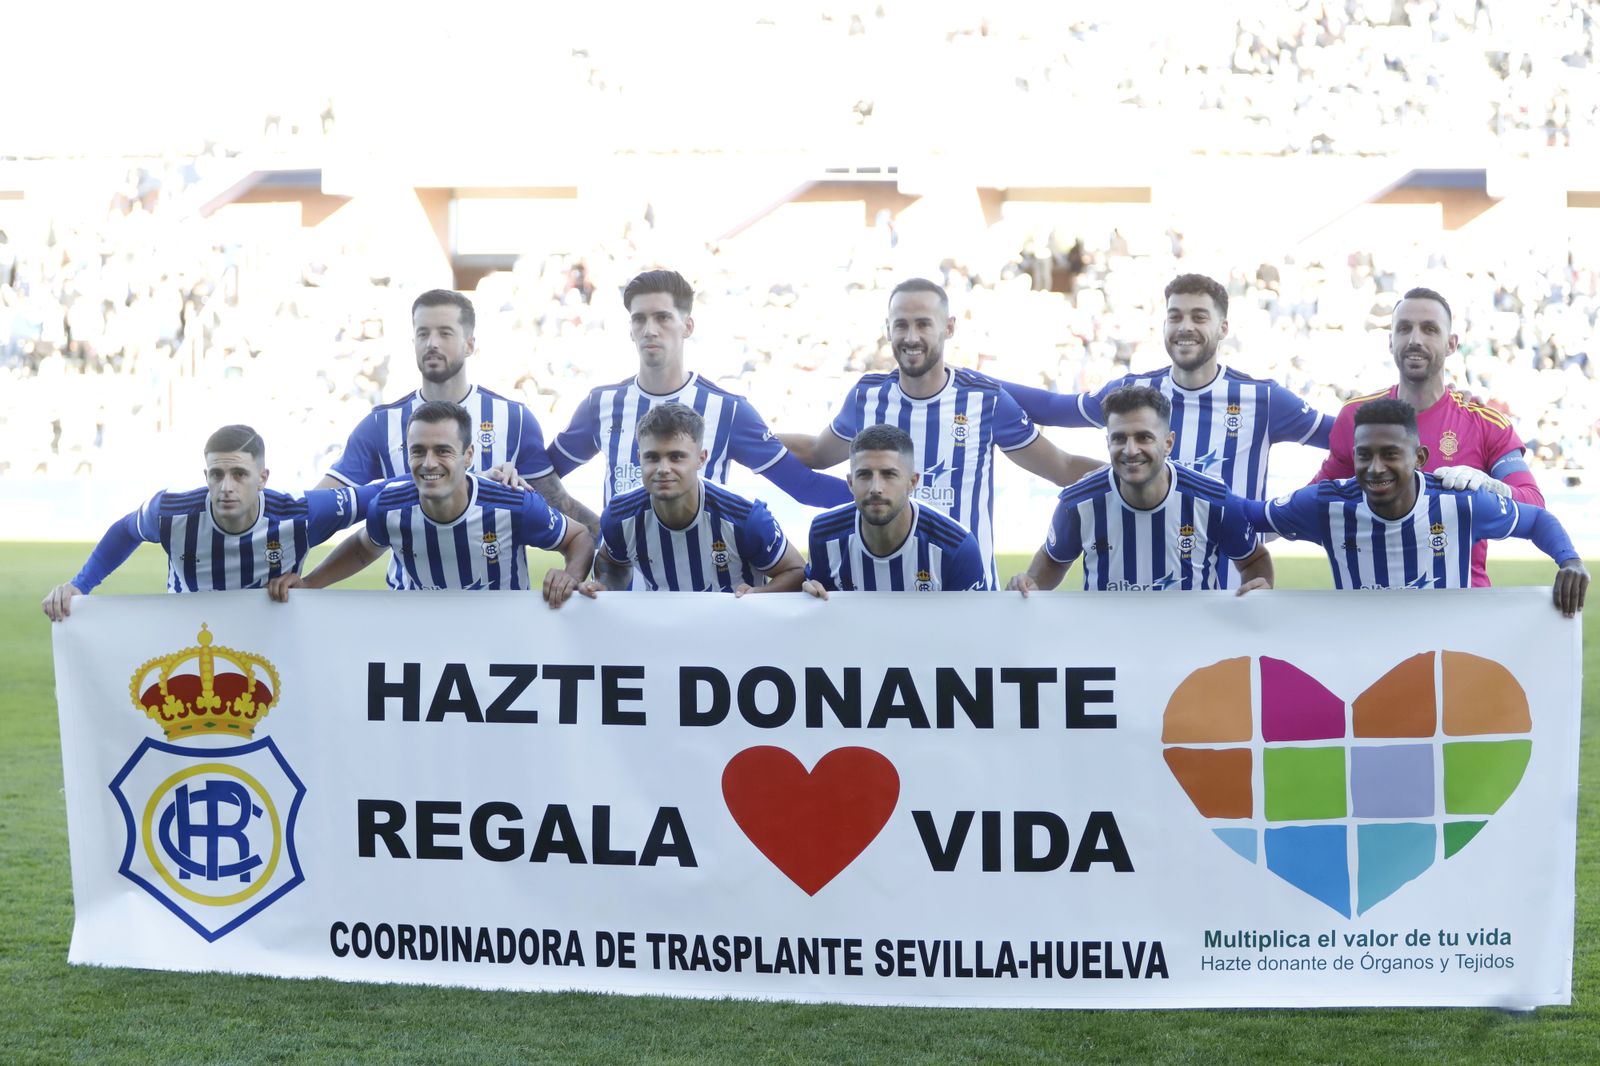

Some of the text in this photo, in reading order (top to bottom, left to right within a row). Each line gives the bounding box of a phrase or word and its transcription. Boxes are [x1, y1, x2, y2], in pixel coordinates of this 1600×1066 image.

[615, 463, 642, 479] alte
[911, 487, 953, 500] rsun
[368, 662, 1117, 729] HAZTE DONANTE
[357, 799, 1135, 872] REGALA VIDA
[330, 921, 1169, 980] COORDINADORA DE TRASPLANTE SEVILLA-HUELVA
[1204, 928, 1512, 952] Multiplica el valor de tu vida
[1201, 951, 1515, 974] Hazte donante de Órganos y Tejidos
